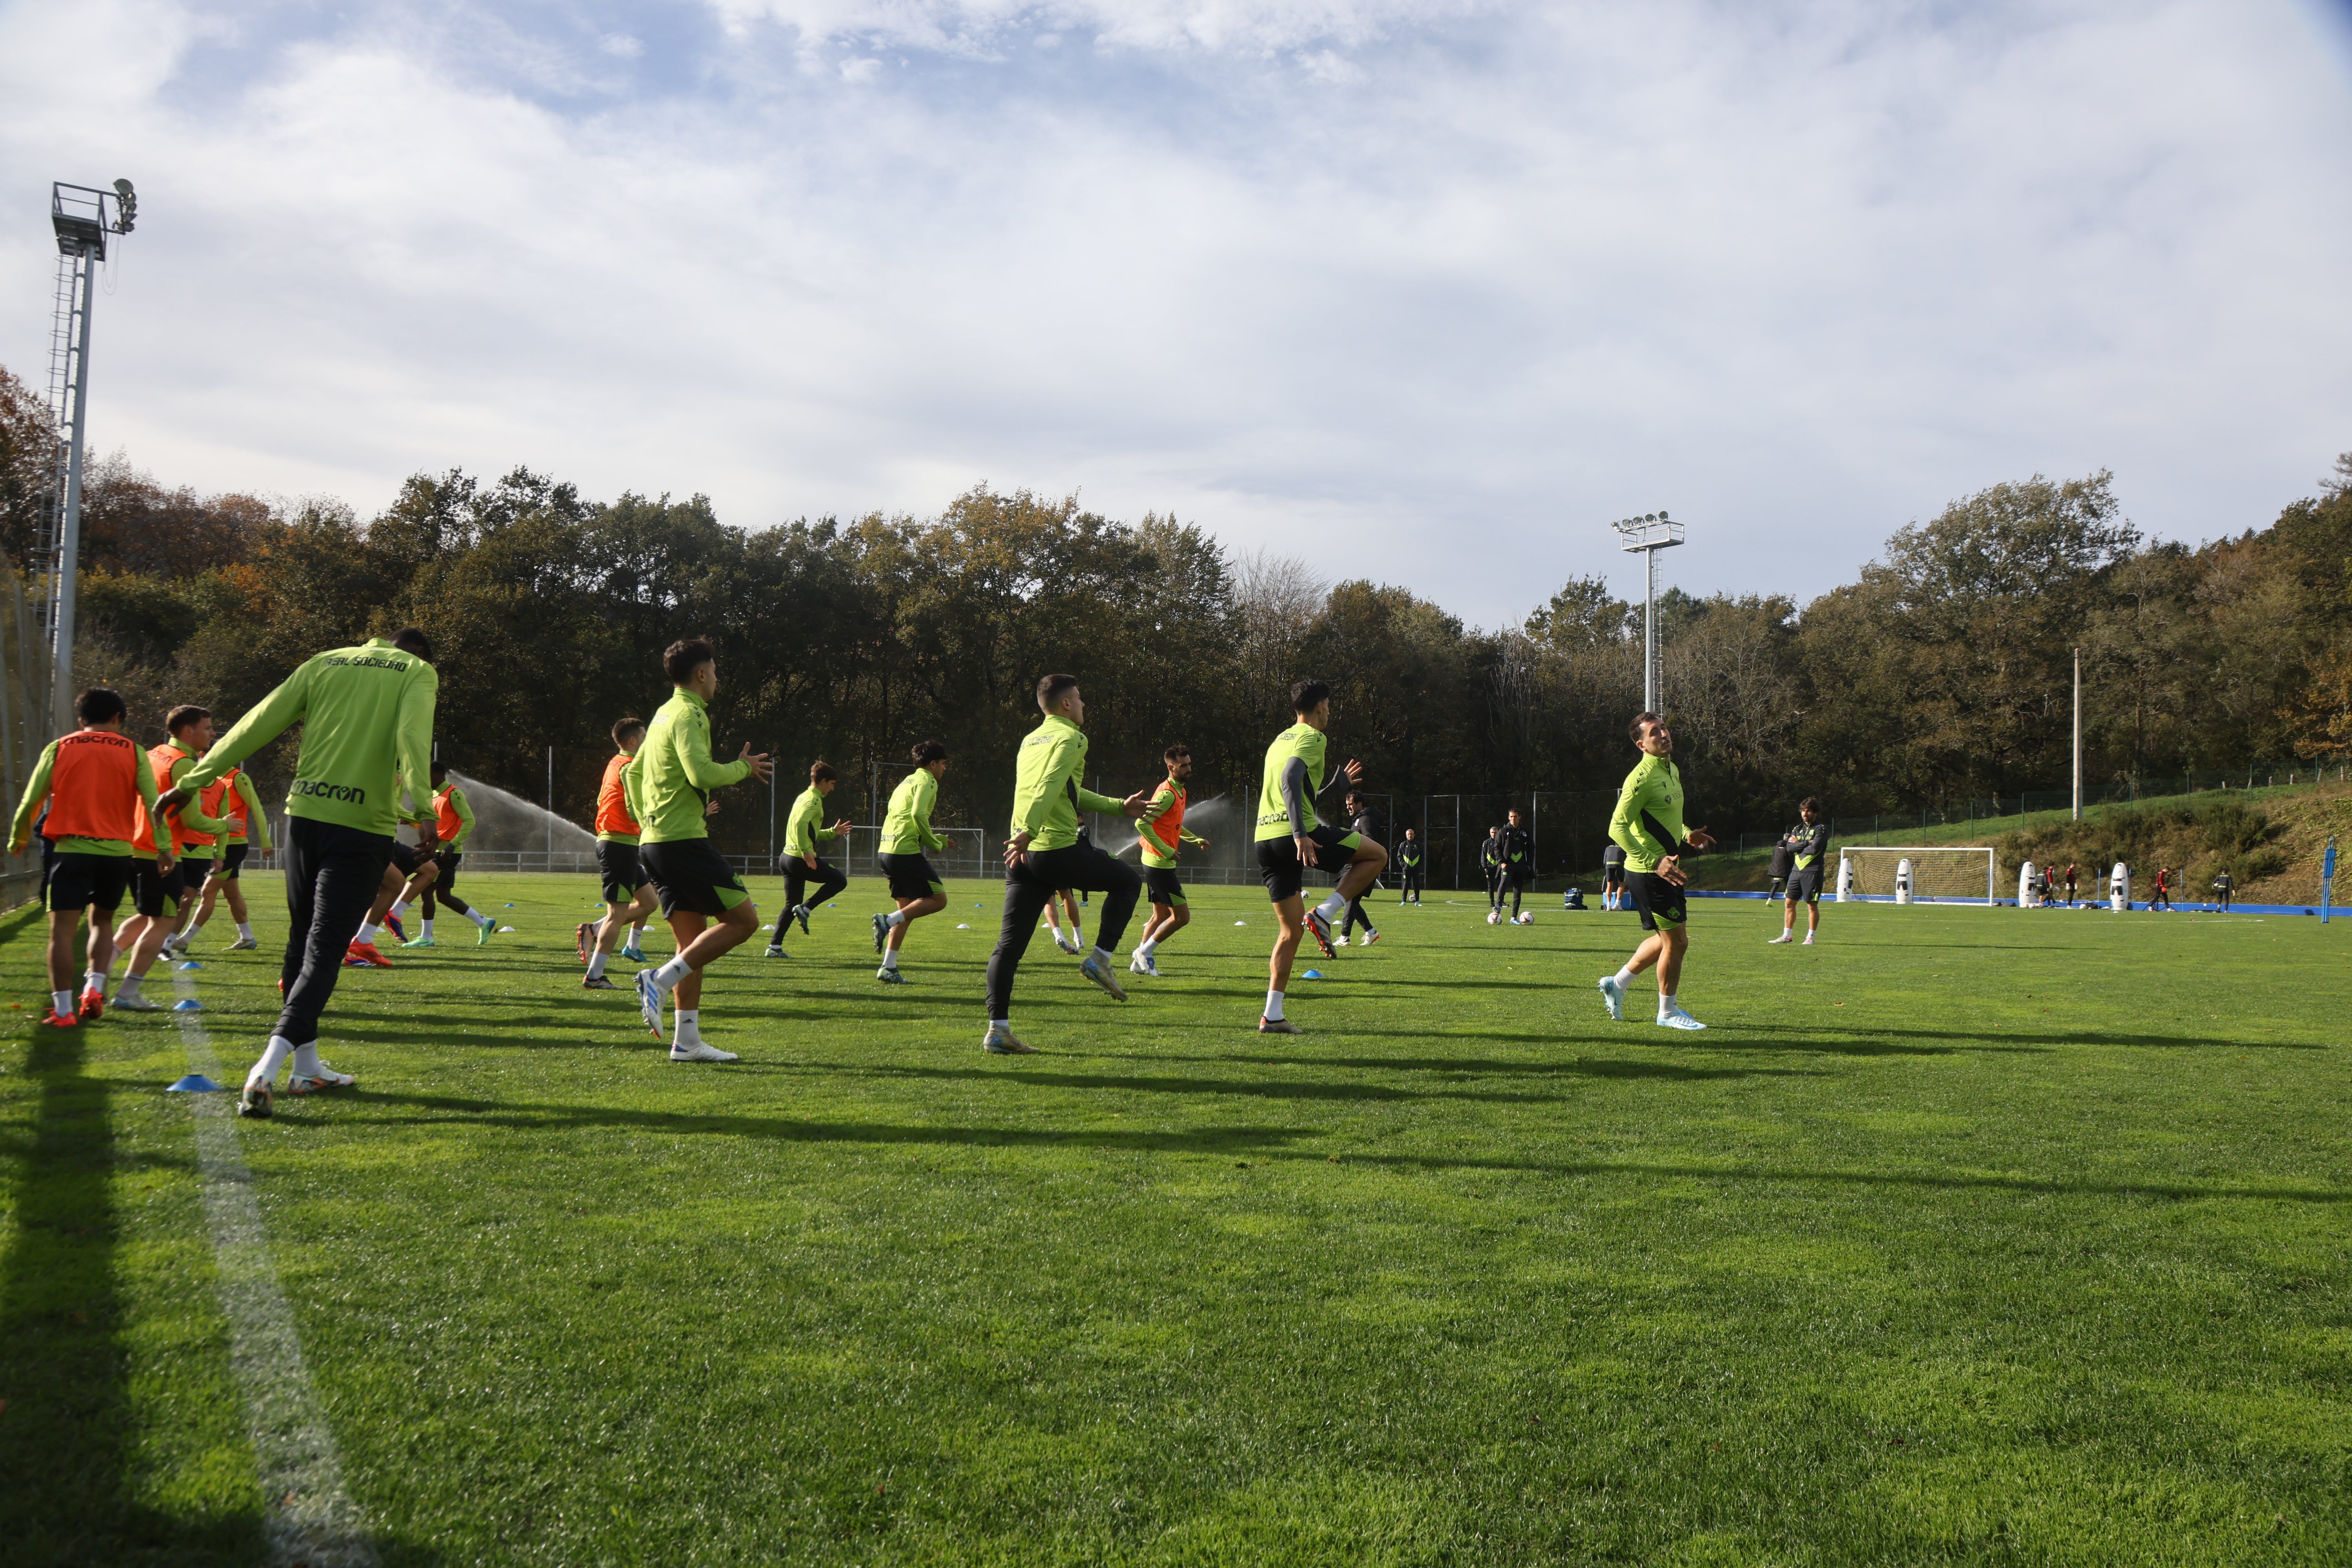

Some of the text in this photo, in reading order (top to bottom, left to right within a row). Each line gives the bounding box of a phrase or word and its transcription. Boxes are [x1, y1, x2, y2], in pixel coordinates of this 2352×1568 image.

[325, 657, 407, 672] REAL SOCIEDAD
[64, 735, 130, 748] macron
[1671, 790, 1684, 800] YASU
